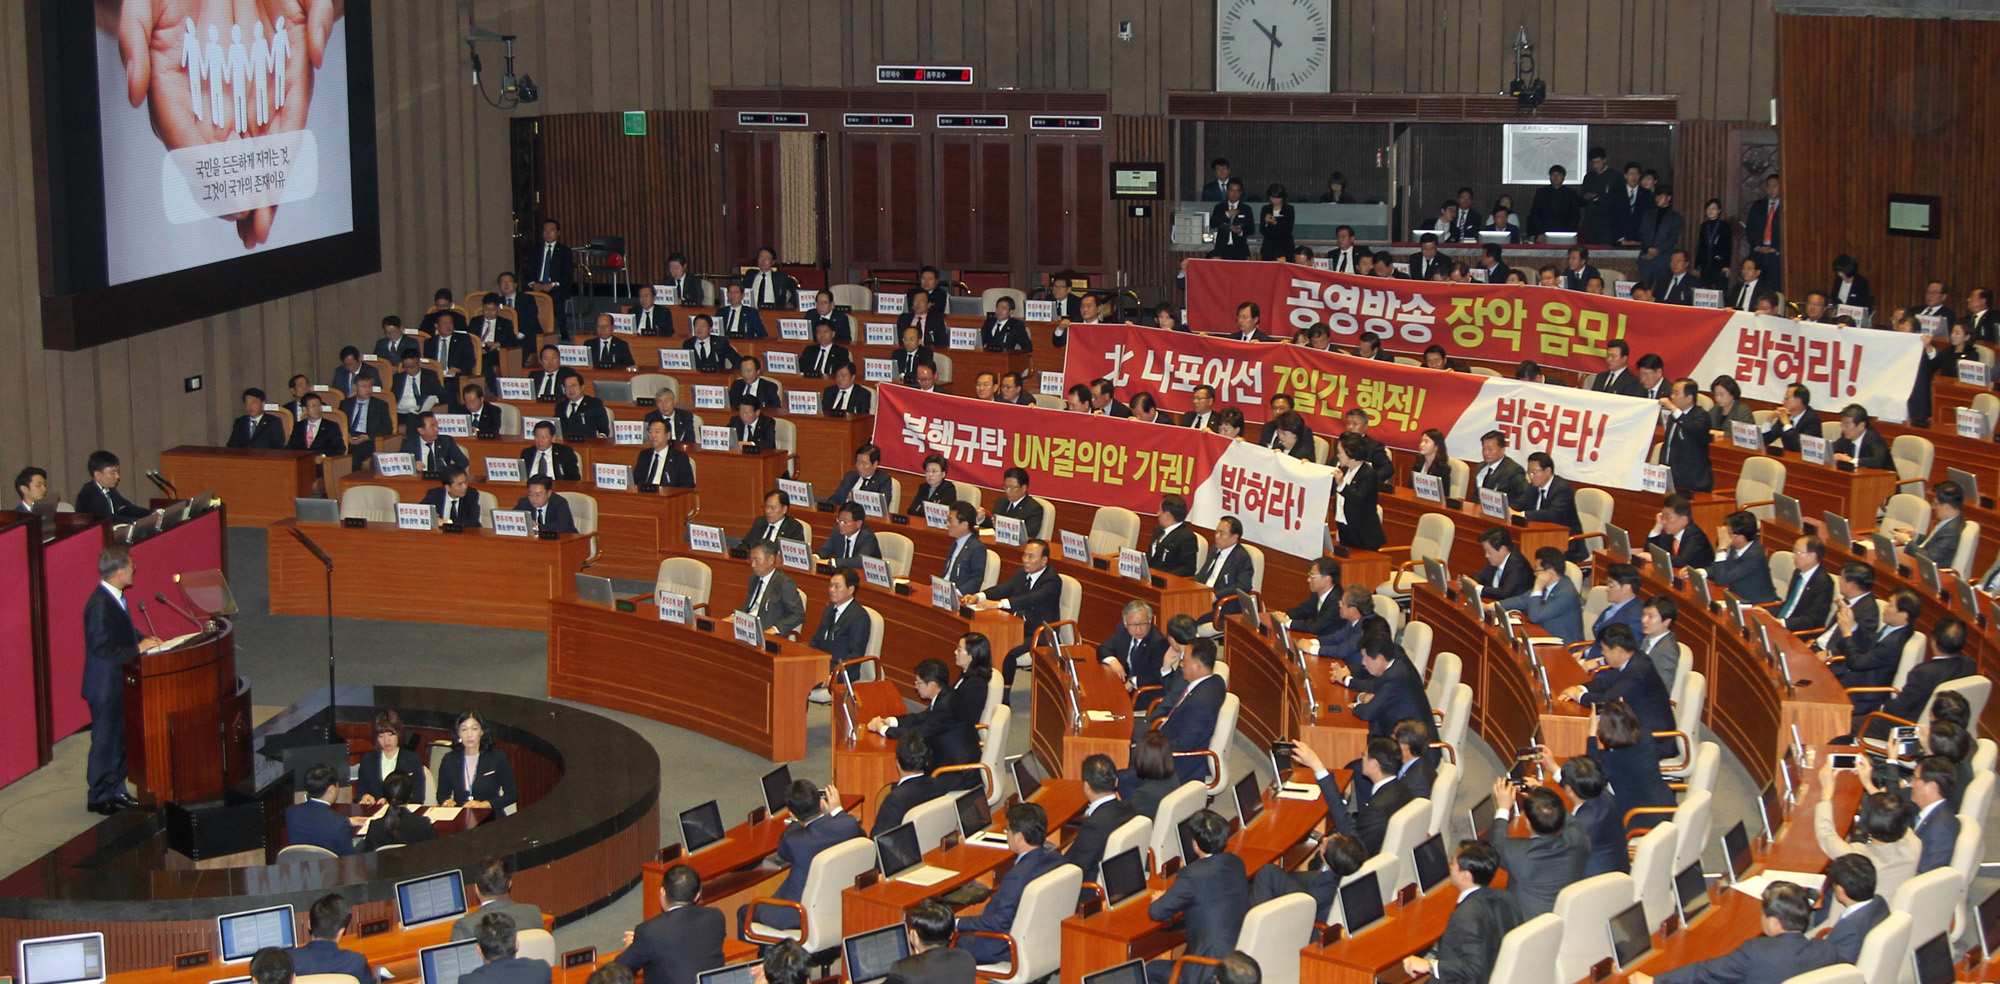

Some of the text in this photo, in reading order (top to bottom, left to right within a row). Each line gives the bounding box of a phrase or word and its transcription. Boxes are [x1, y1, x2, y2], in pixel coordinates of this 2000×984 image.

[914, 69, 924, 80] 0
[961, 69, 969, 80] 0
[195, 146, 290, 178] 국민을 든든하게 지키는 것,
[203, 171, 286, 201] 그것이 국가의 존재이유
[1286, 278, 1863, 398] 공영방송 장악 음모! 밝혀라!
[1103, 344, 1609, 462] 北 나포어선 7일간 행적! 밝혀라!
[902, 413, 1306, 530] 북핵규탄 UN결의안 기권! 밝혀라!
